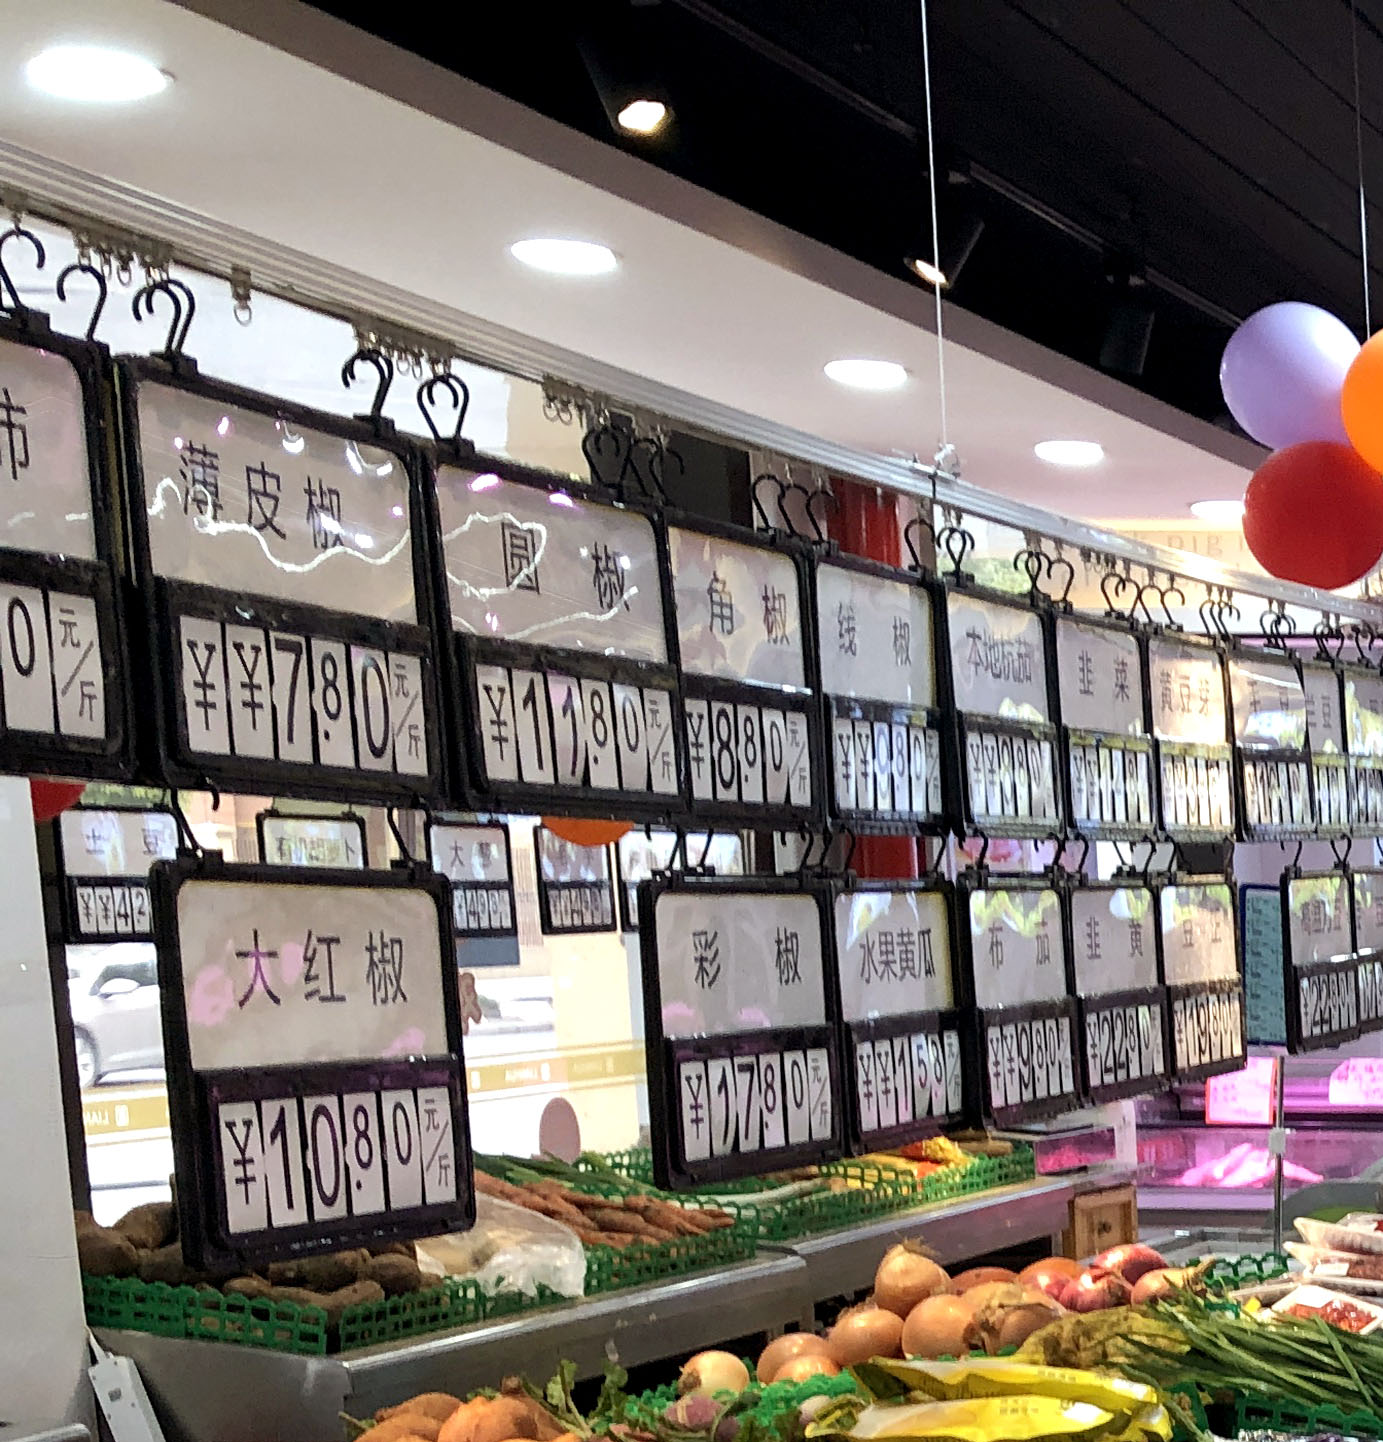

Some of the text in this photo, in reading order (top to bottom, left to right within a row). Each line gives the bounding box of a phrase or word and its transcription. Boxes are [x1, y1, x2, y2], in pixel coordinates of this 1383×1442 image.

[180, 440, 345, 551] 薄皮椒
[501, 522, 632, 613] 圆椒
[706, 571, 790, 647] 角椒
[838, 602, 912, 667] 线椒
[236, 928, 408, 1009] 大红椒
[692, 926, 802, 989] 彩椒
[859, 927, 936, 985] 水果黄瓜
